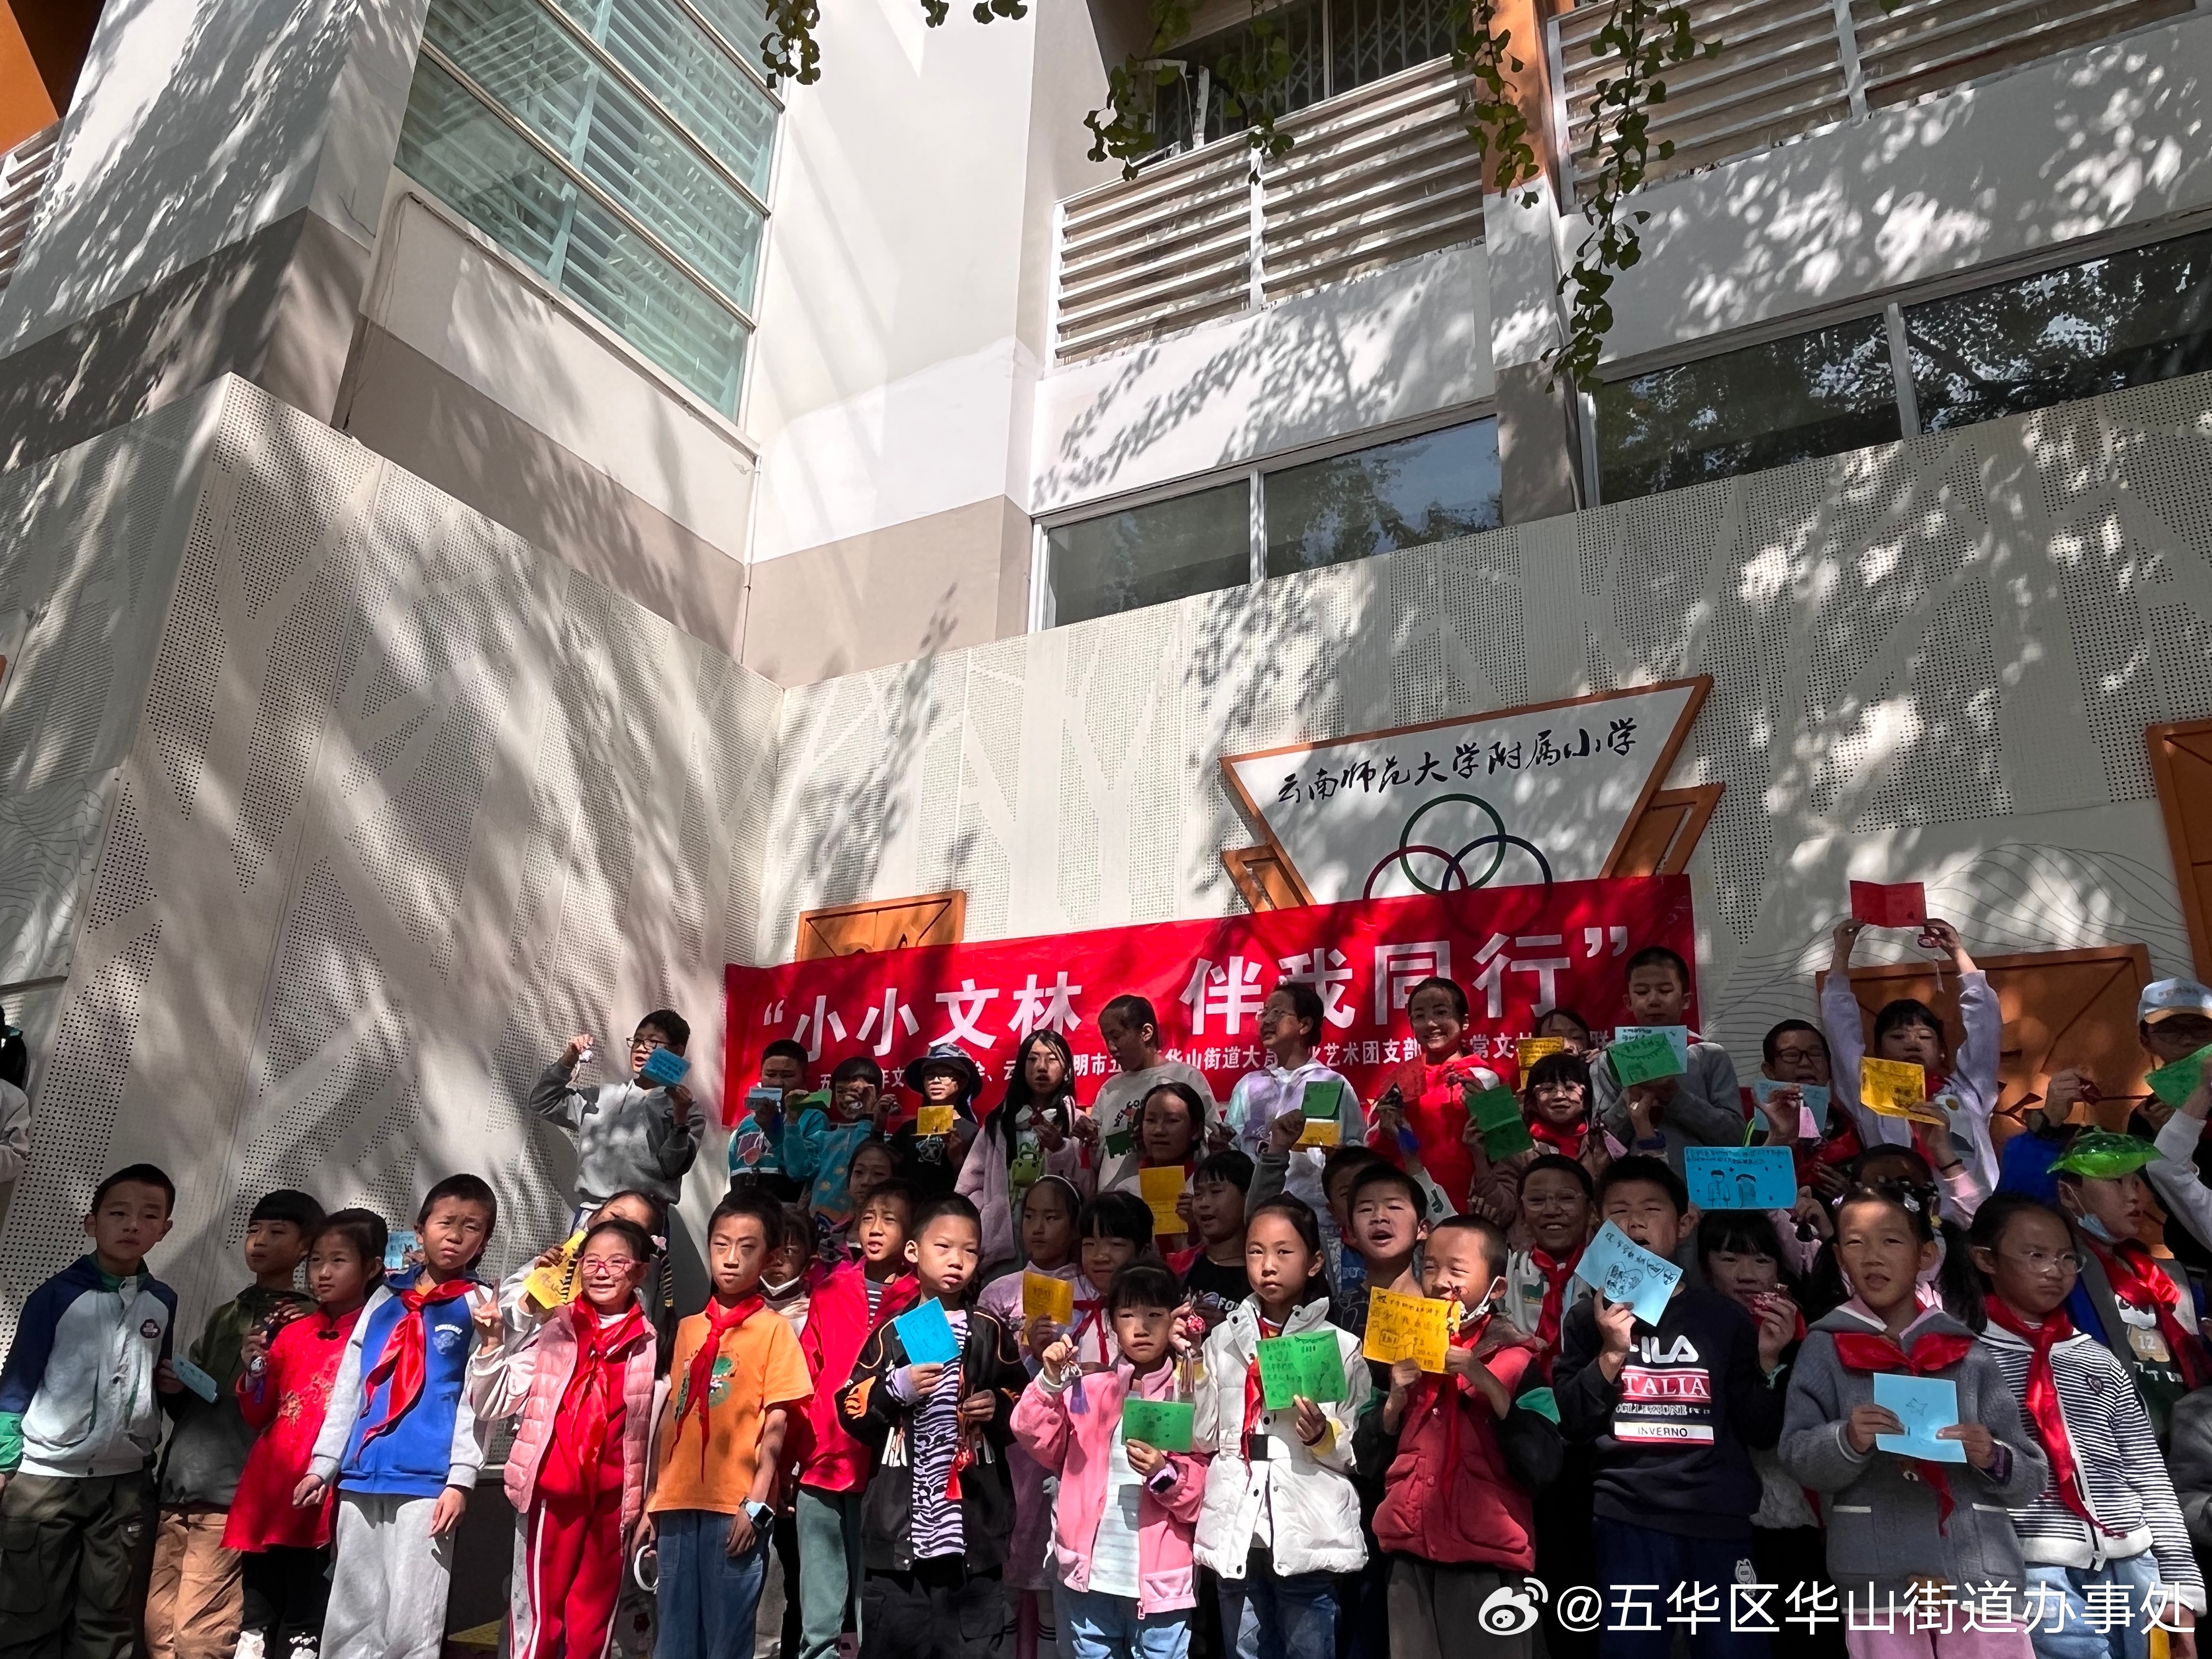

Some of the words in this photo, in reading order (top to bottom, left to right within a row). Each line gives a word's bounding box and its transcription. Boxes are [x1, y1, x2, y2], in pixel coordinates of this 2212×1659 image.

[1277, 716, 1638, 804] 云南师范大学附属小学
[2138, 1335, 2157, 1350] 12
[1638, 1427, 1688, 1437] INVERNO
